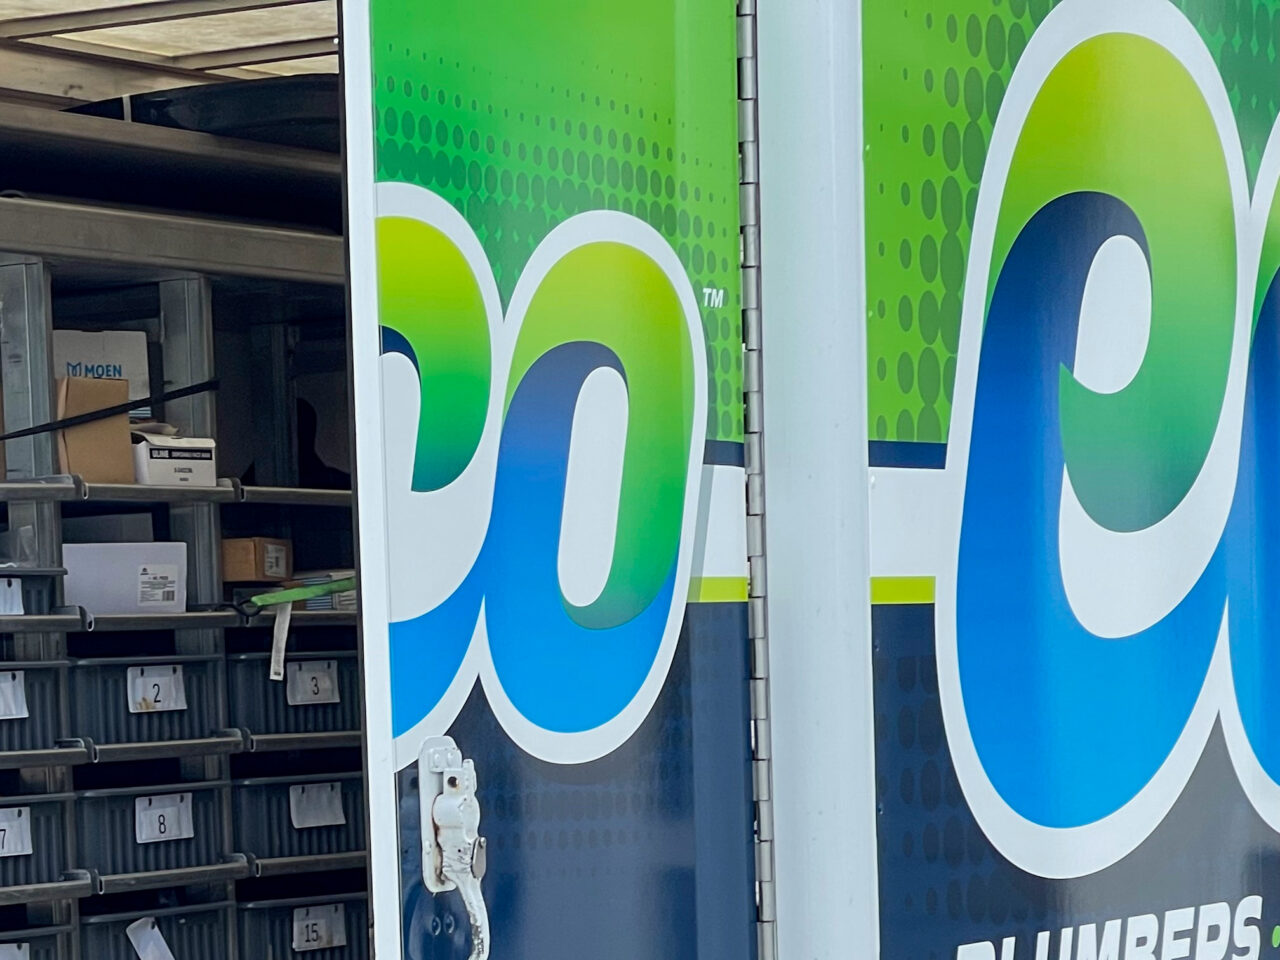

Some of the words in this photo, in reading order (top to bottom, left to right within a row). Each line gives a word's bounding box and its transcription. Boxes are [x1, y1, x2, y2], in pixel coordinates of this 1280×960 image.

[85, 364, 122, 377] MOEN
[152, 683, 162, 703] 2
[311, 677, 320, 695] 3
[157, 814, 167, 834] 8
[304, 923, 319, 943] 15
